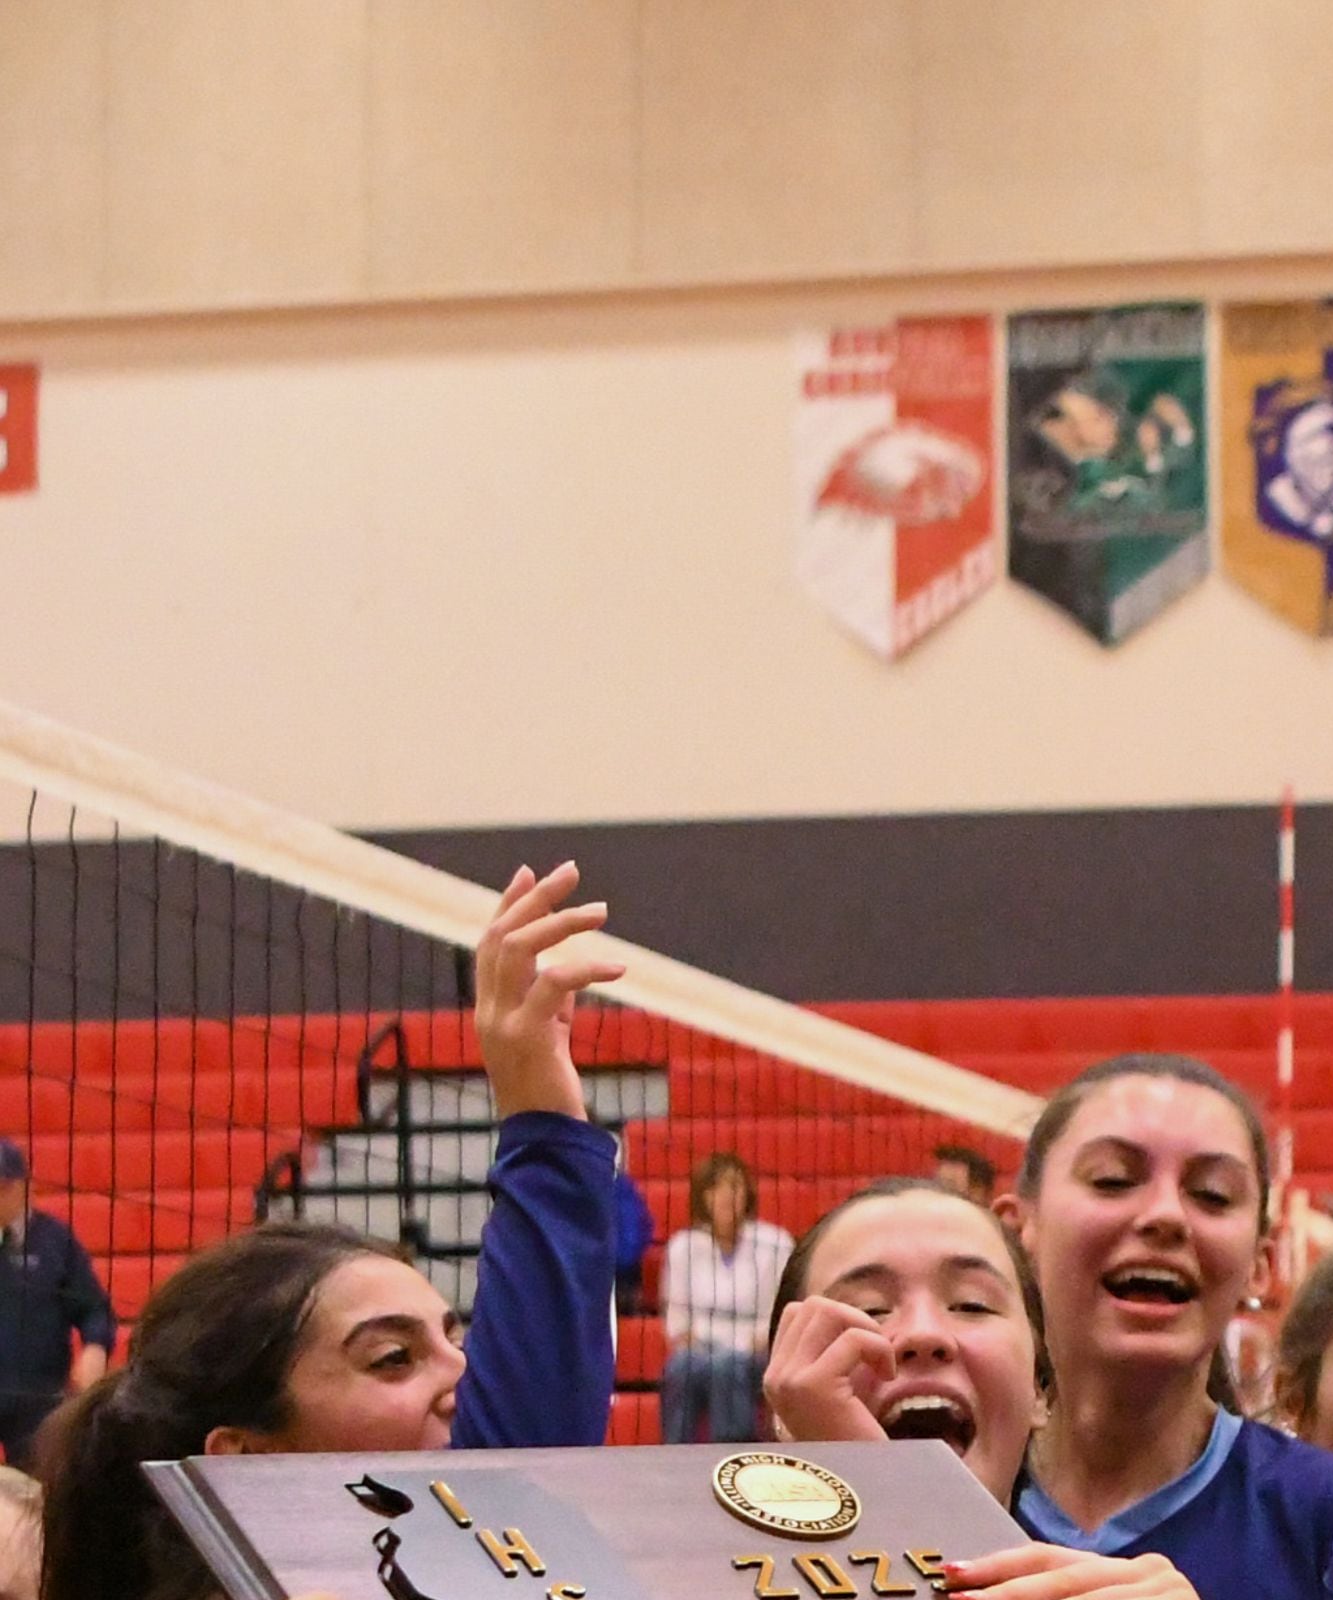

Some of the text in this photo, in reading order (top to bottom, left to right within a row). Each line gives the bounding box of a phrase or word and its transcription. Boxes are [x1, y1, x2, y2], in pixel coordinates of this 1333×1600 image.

[720, 1462, 745, 1504] ILLINOIS
[740, 1454, 786, 1466] HIGH
[795, 1460, 854, 1503] SCHOOL
[750, 1507, 855, 1531] ASSOCIATION
